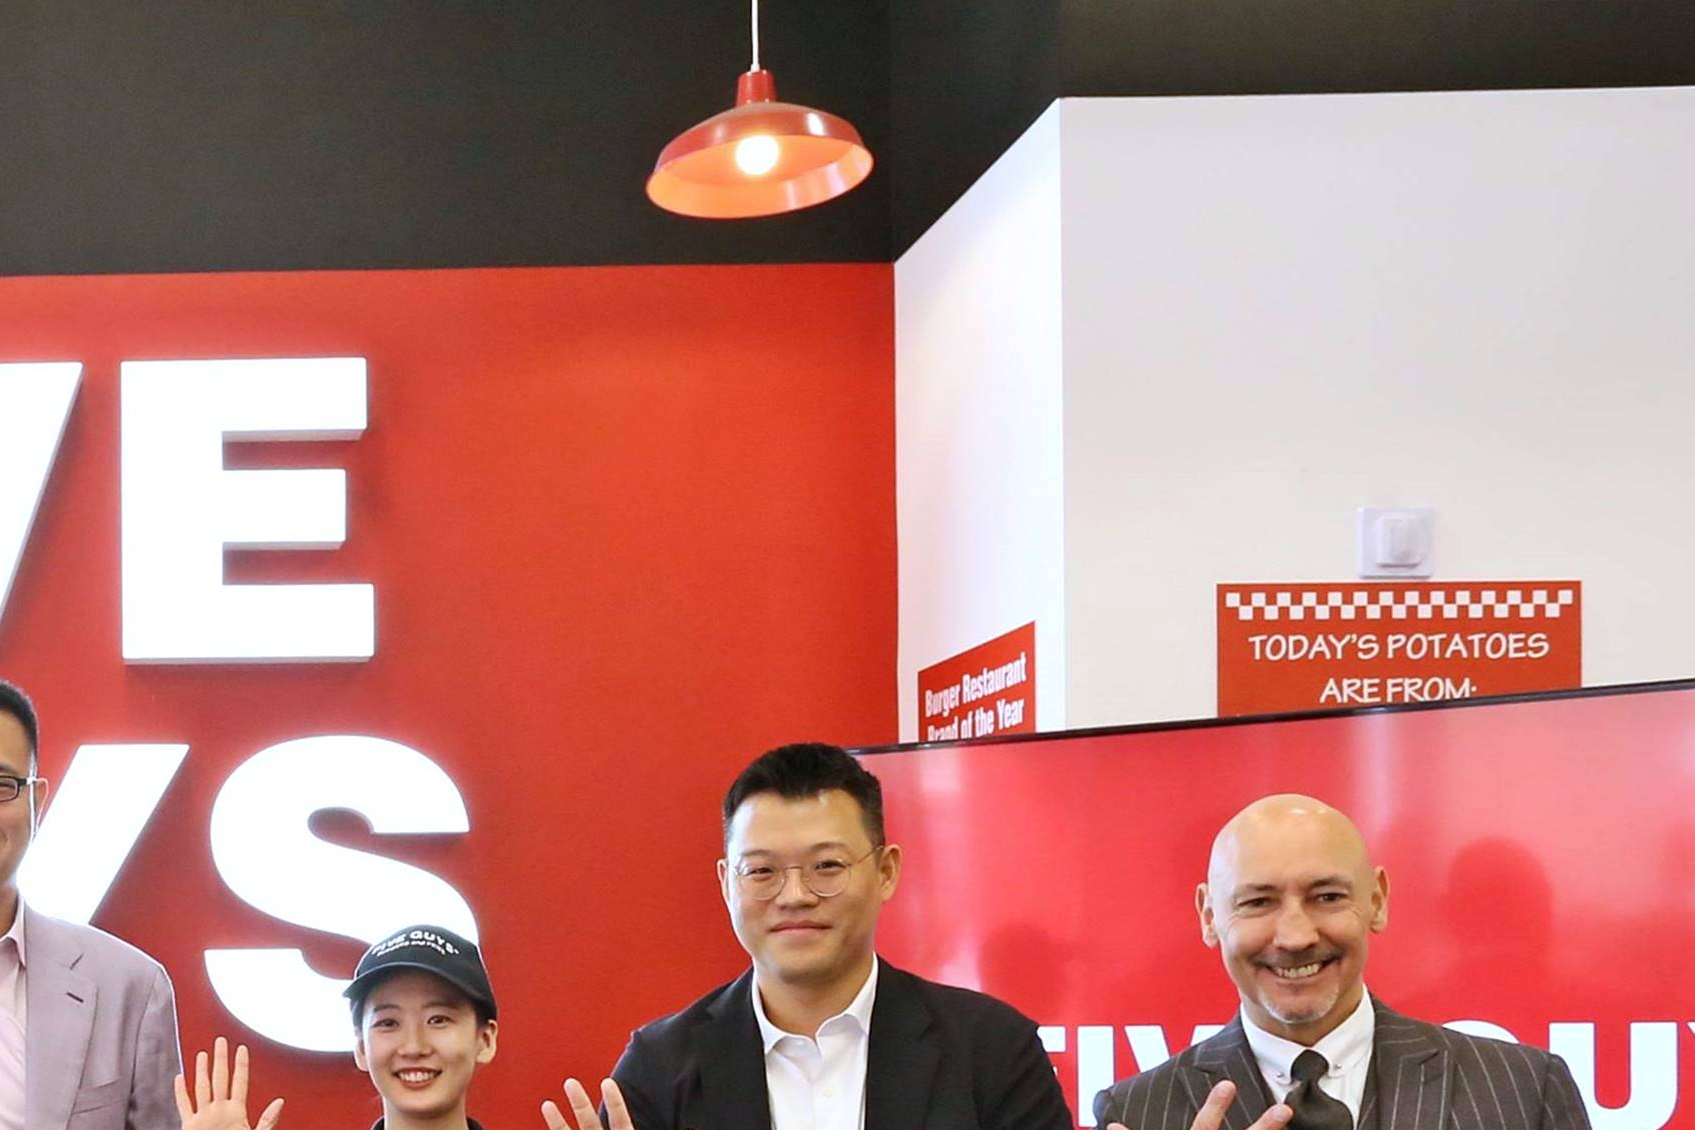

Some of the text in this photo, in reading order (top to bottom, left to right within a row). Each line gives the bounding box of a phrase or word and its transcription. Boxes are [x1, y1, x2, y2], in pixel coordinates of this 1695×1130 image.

[1248, 632, 1550, 661] TODAY'S POTATOES
[925, 651, 1027, 718] Burger Restaurant
[1319, 677, 1381, 703] ARE
[961, 710, 973, 739] of
[974, 706, 994, 738] the
[996, 698, 1025, 730] Year
